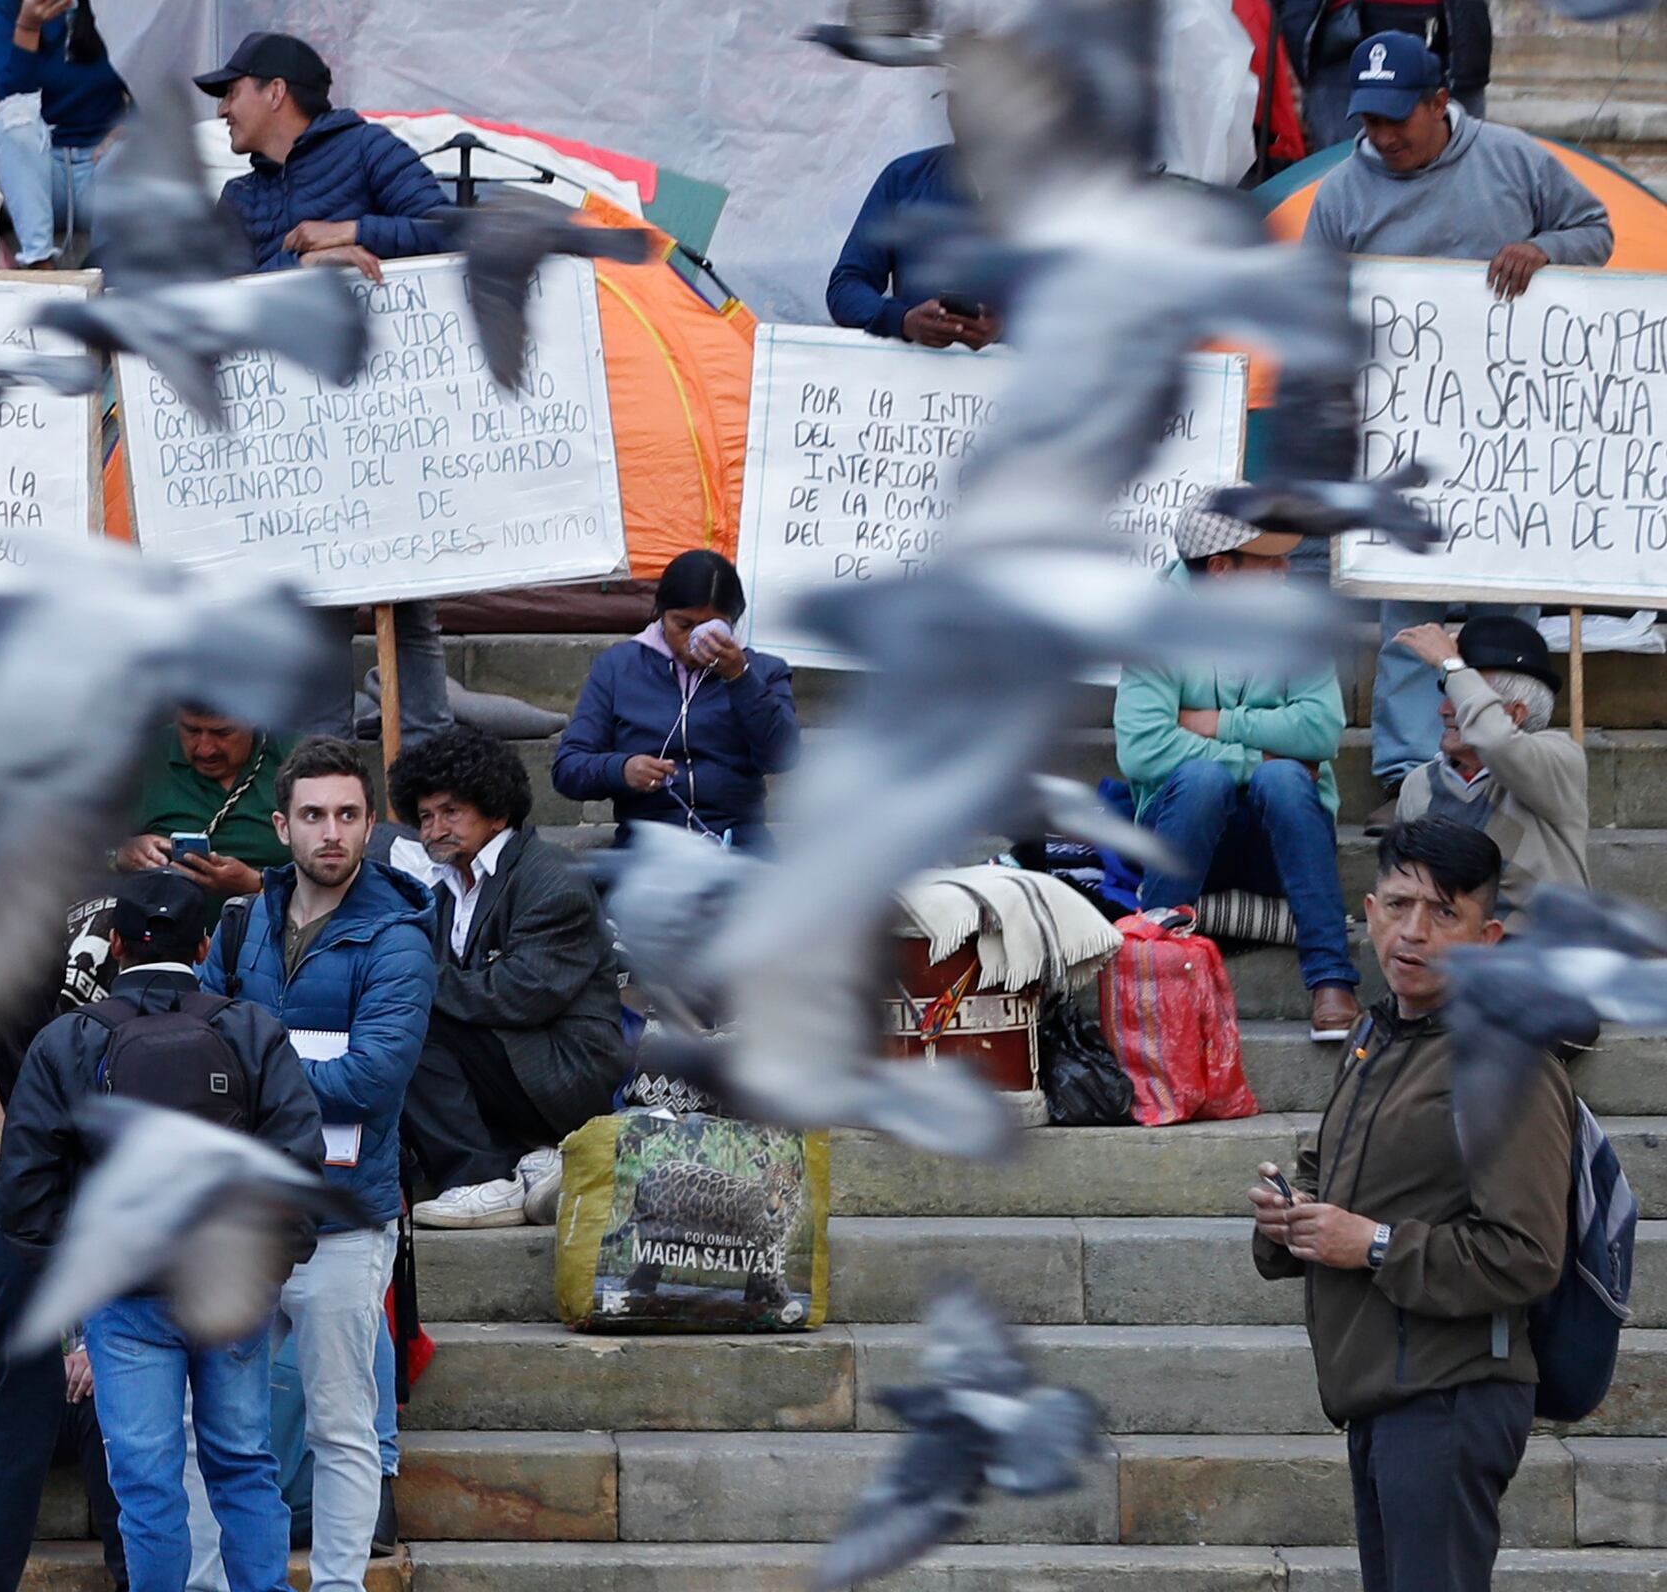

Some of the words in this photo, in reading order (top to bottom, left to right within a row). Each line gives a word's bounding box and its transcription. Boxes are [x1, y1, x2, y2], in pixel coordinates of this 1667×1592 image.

[393, 311, 463, 347] VIDA
[1371, 296, 1443, 361] POR
[1487, 302, 1527, 366] EL
[1542, 305, 1667, 375] CUMPLI
[149, 363, 287, 405] ESITUAL
[801, 382, 841, 414] POR
[869, 388, 893, 419] LA
[1358, 364, 1408, 423] DE
[1425, 365, 1465, 429] LA
[1477, 362, 1652, 436] SENTENCIA
[160, 426, 328, 477] DESAPARICIÓN
[344, 416, 450, 456] FORZADA
[472, 412, 514, 443] DEL
[521, 402, 588, 438] PUEBLO
[795, 420, 835, 448] DEL
[858, 421, 978, 458] MINISTER
[9, 466, 36, 498] LA
[167, 466, 323, 509] ORIGINARIO
[351, 456, 395, 489] DEL
[423, 438, 573, 482] RESGUARDO
[804, 452, 938, 491] INTERIOR
[1443, 432, 1539, 493] 2014
[1550, 437, 1613, 500] DEL
[1623, 439, 1667, 500] RE
[235, 494, 371, 544] INDÍGENA
[418, 489, 457, 520] DE
[789, 486, 819, 513] DE
[842, 489, 867, 518] LA
[502, 514, 597, 549] Nariño
[785, 520, 824, 547] DEL
[1572, 501, 1614, 550] DE
[835, 553, 871, 581] DE
[632, 1240, 698, 1269] MAGIA
[702, 1245, 786, 1275] SALVAJE
[684, 1230, 743, 1247] COLOMBIA
